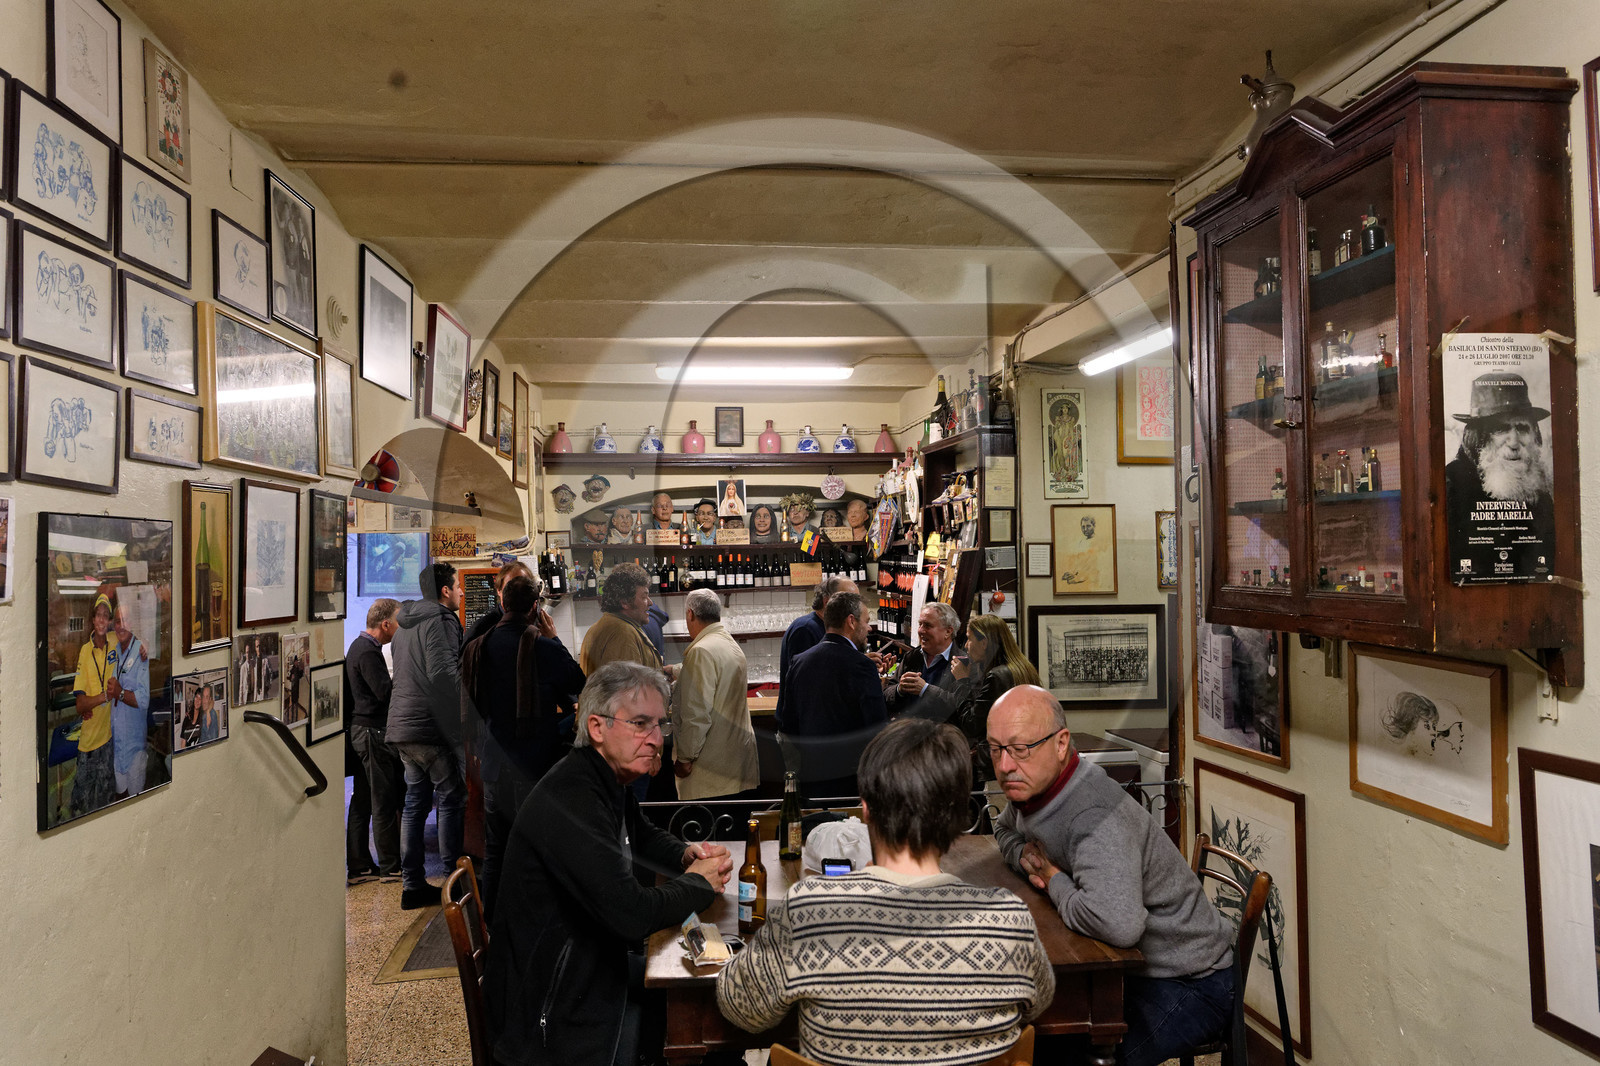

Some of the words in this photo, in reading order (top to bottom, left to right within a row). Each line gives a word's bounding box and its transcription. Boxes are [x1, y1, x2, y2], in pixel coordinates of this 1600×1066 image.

[1476, 501, 1520, 510] INTERVISTA
[1522, 501, 1527, 510] A
[1470, 512, 1495, 520] PADRE
[1497, 511, 1534, 520] MARELLA
